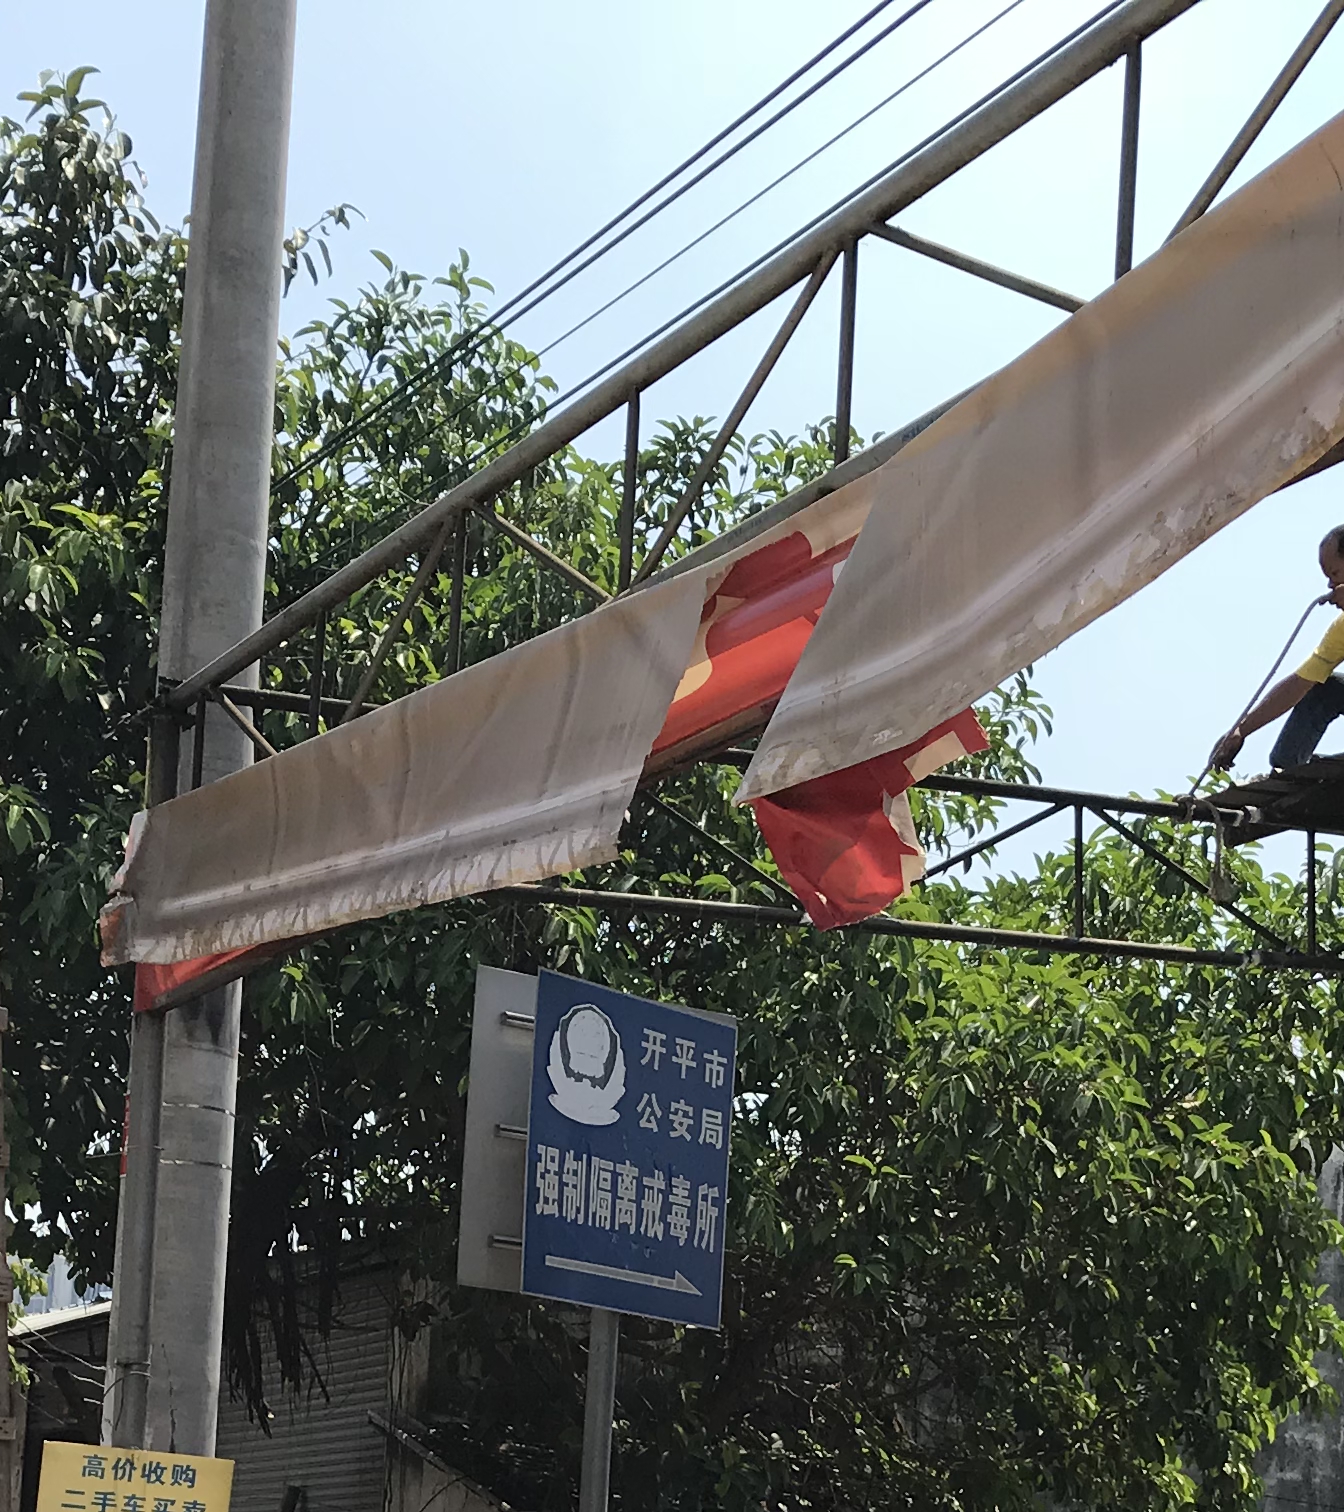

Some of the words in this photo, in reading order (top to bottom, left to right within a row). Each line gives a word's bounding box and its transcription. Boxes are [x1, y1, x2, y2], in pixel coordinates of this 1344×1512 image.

[640, 1027, 728, 1089] 开平市
[635, 1092, 723, 1150] 公安局
[535, 1144, 719, 1253] 强制隔离戒毒所
[81, 1454, 197, 1488] 高价收购
